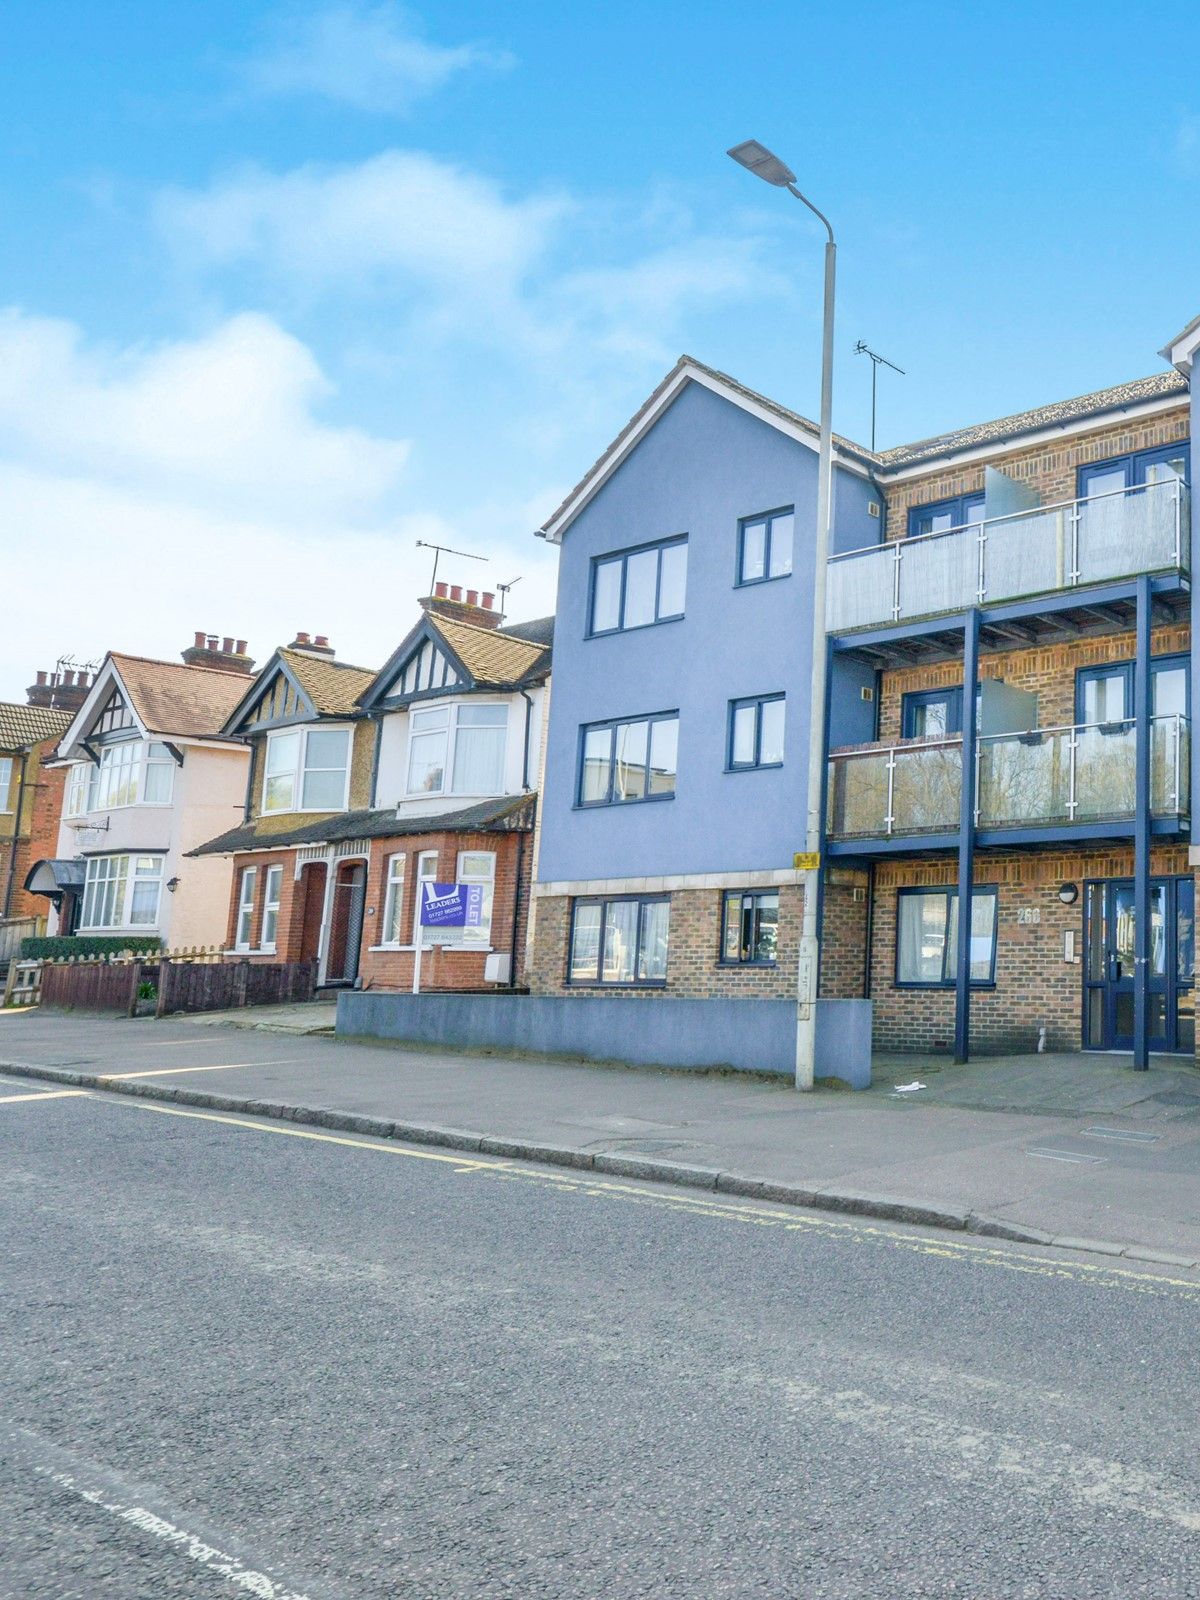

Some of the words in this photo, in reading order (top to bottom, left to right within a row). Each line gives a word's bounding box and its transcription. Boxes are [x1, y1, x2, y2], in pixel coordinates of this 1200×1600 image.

[470, 887, 481, 902] TO
[425, 896, 461, 911] LEADERS
[468, 904, 479, 924] LET
